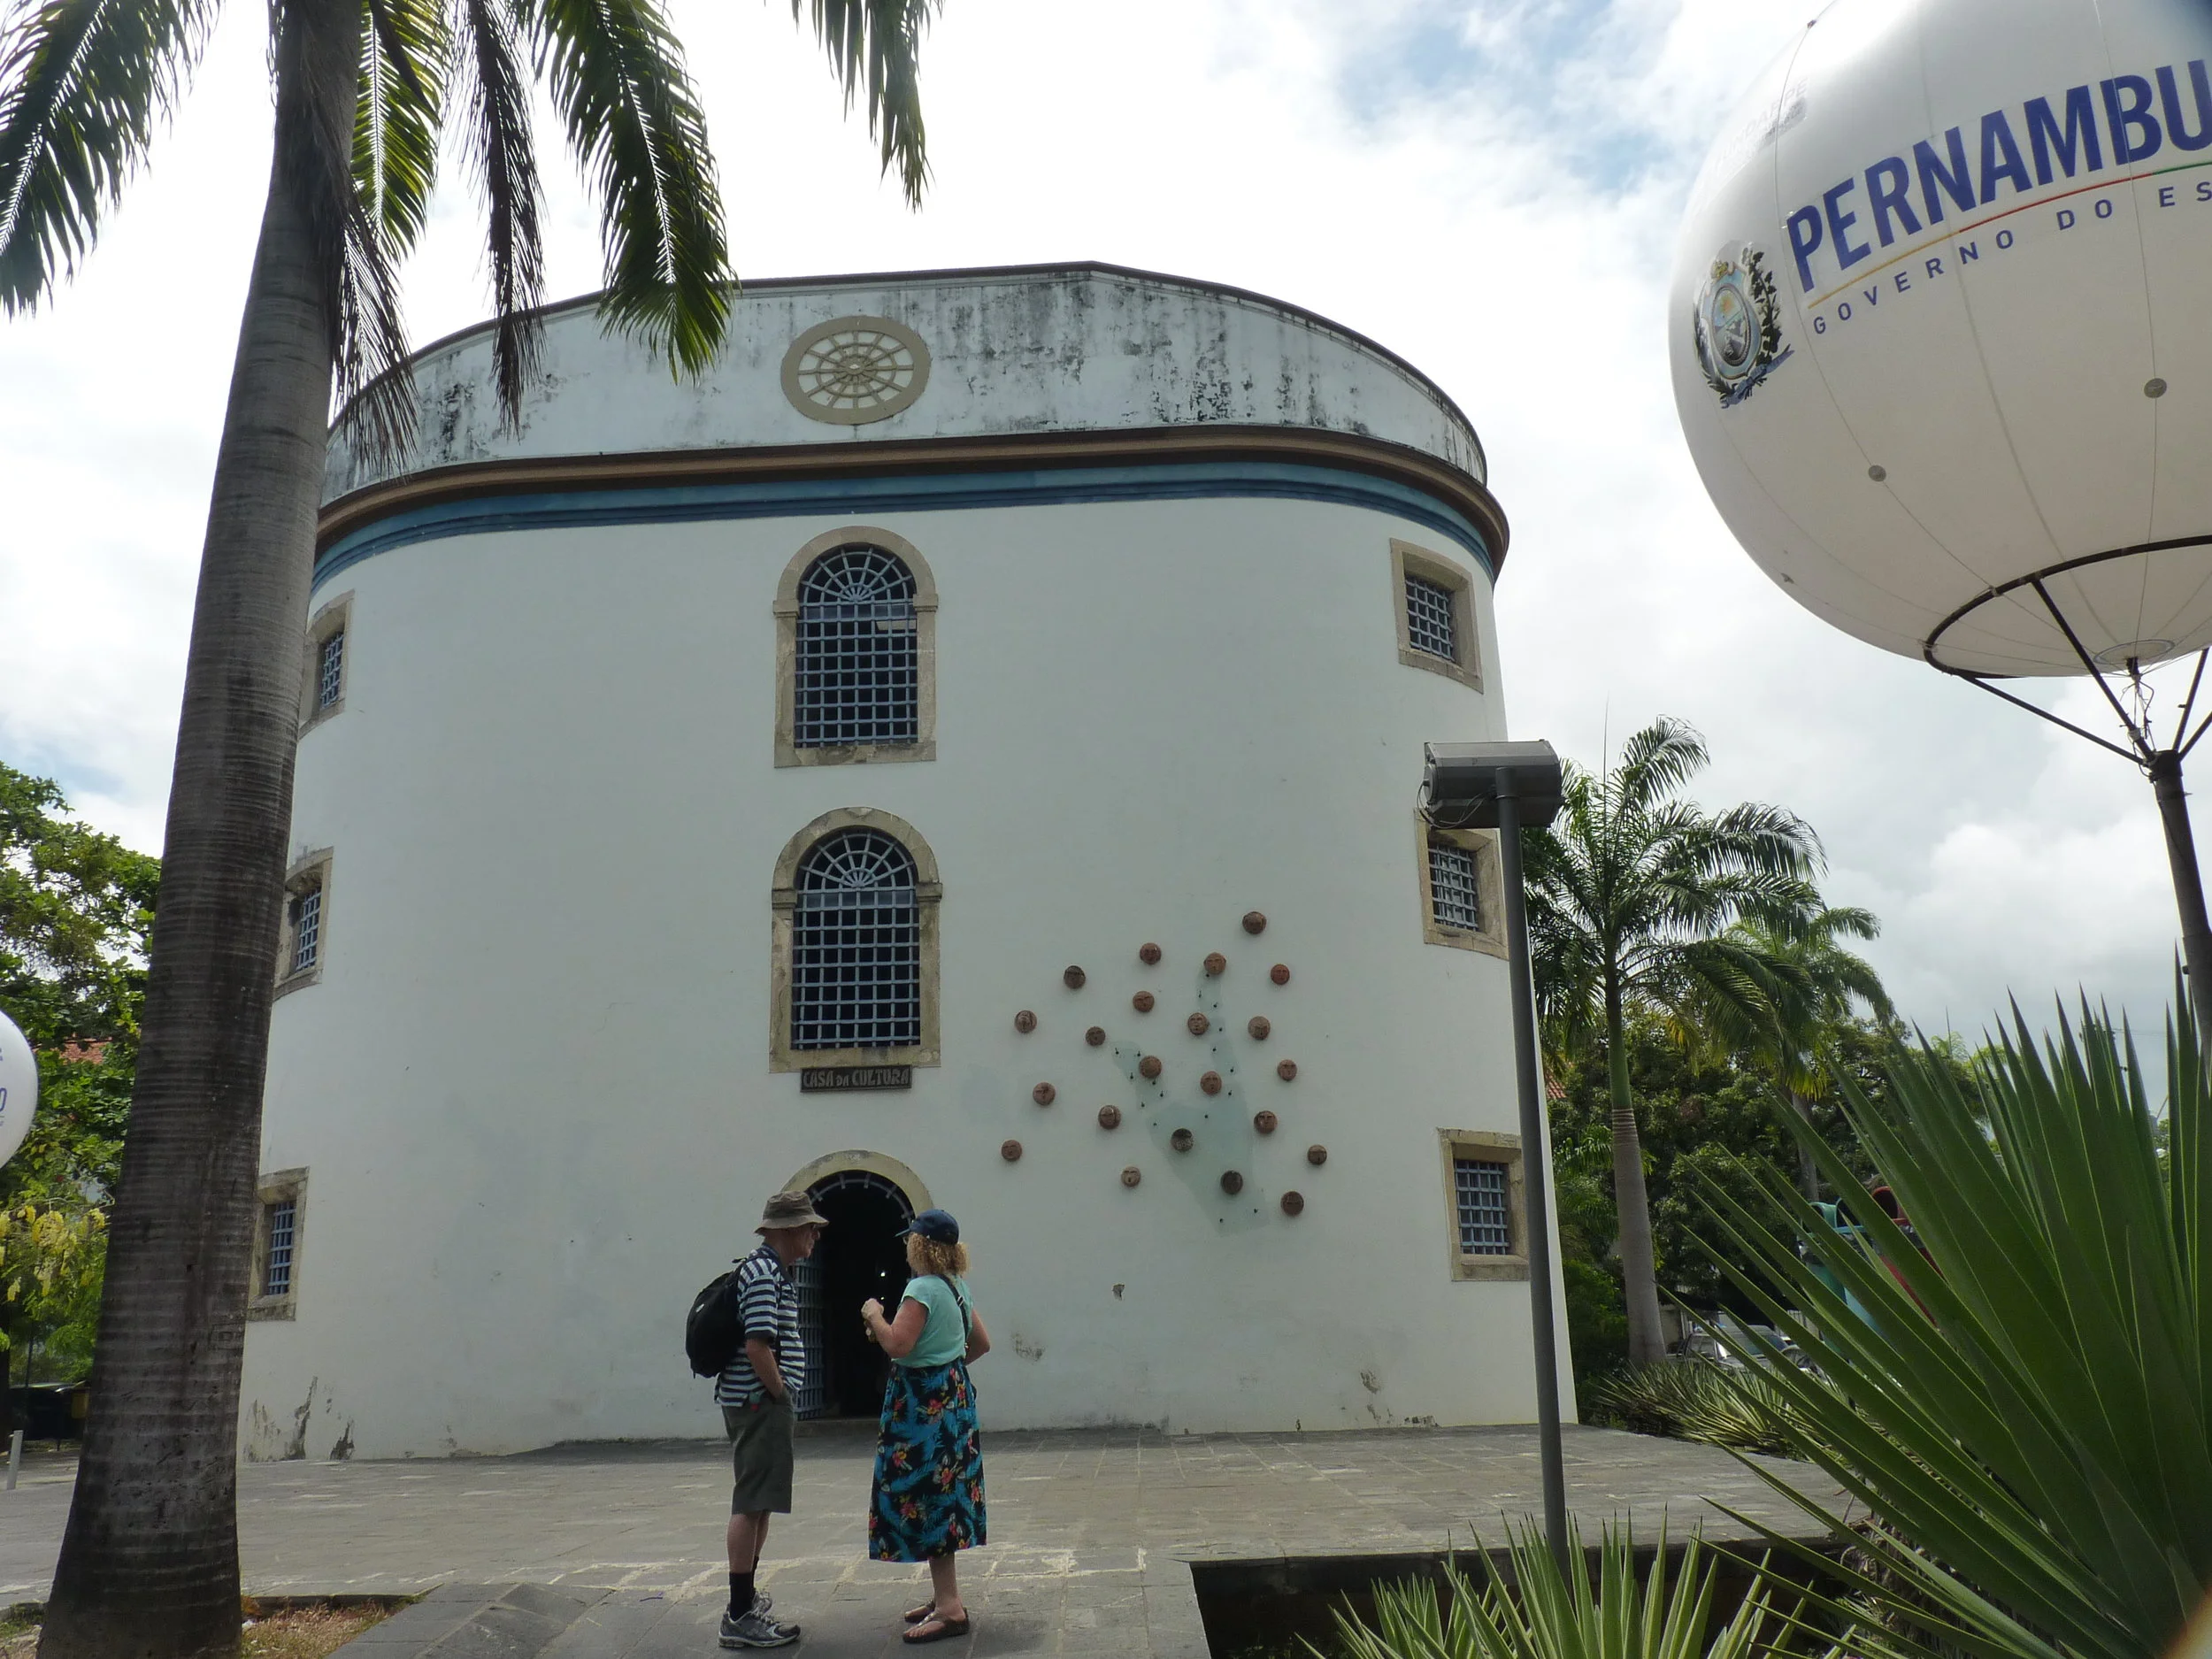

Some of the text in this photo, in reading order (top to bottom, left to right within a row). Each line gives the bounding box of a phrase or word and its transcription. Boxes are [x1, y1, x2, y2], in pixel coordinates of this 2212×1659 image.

[1786, 58, 2212, 293] PERNAMBU
[1813, 181, 2212, 334] GOVERNO DO ES
[803, 1070, 833, 1087] CASA
[852, 1068, 909, 1087] CULTURA
